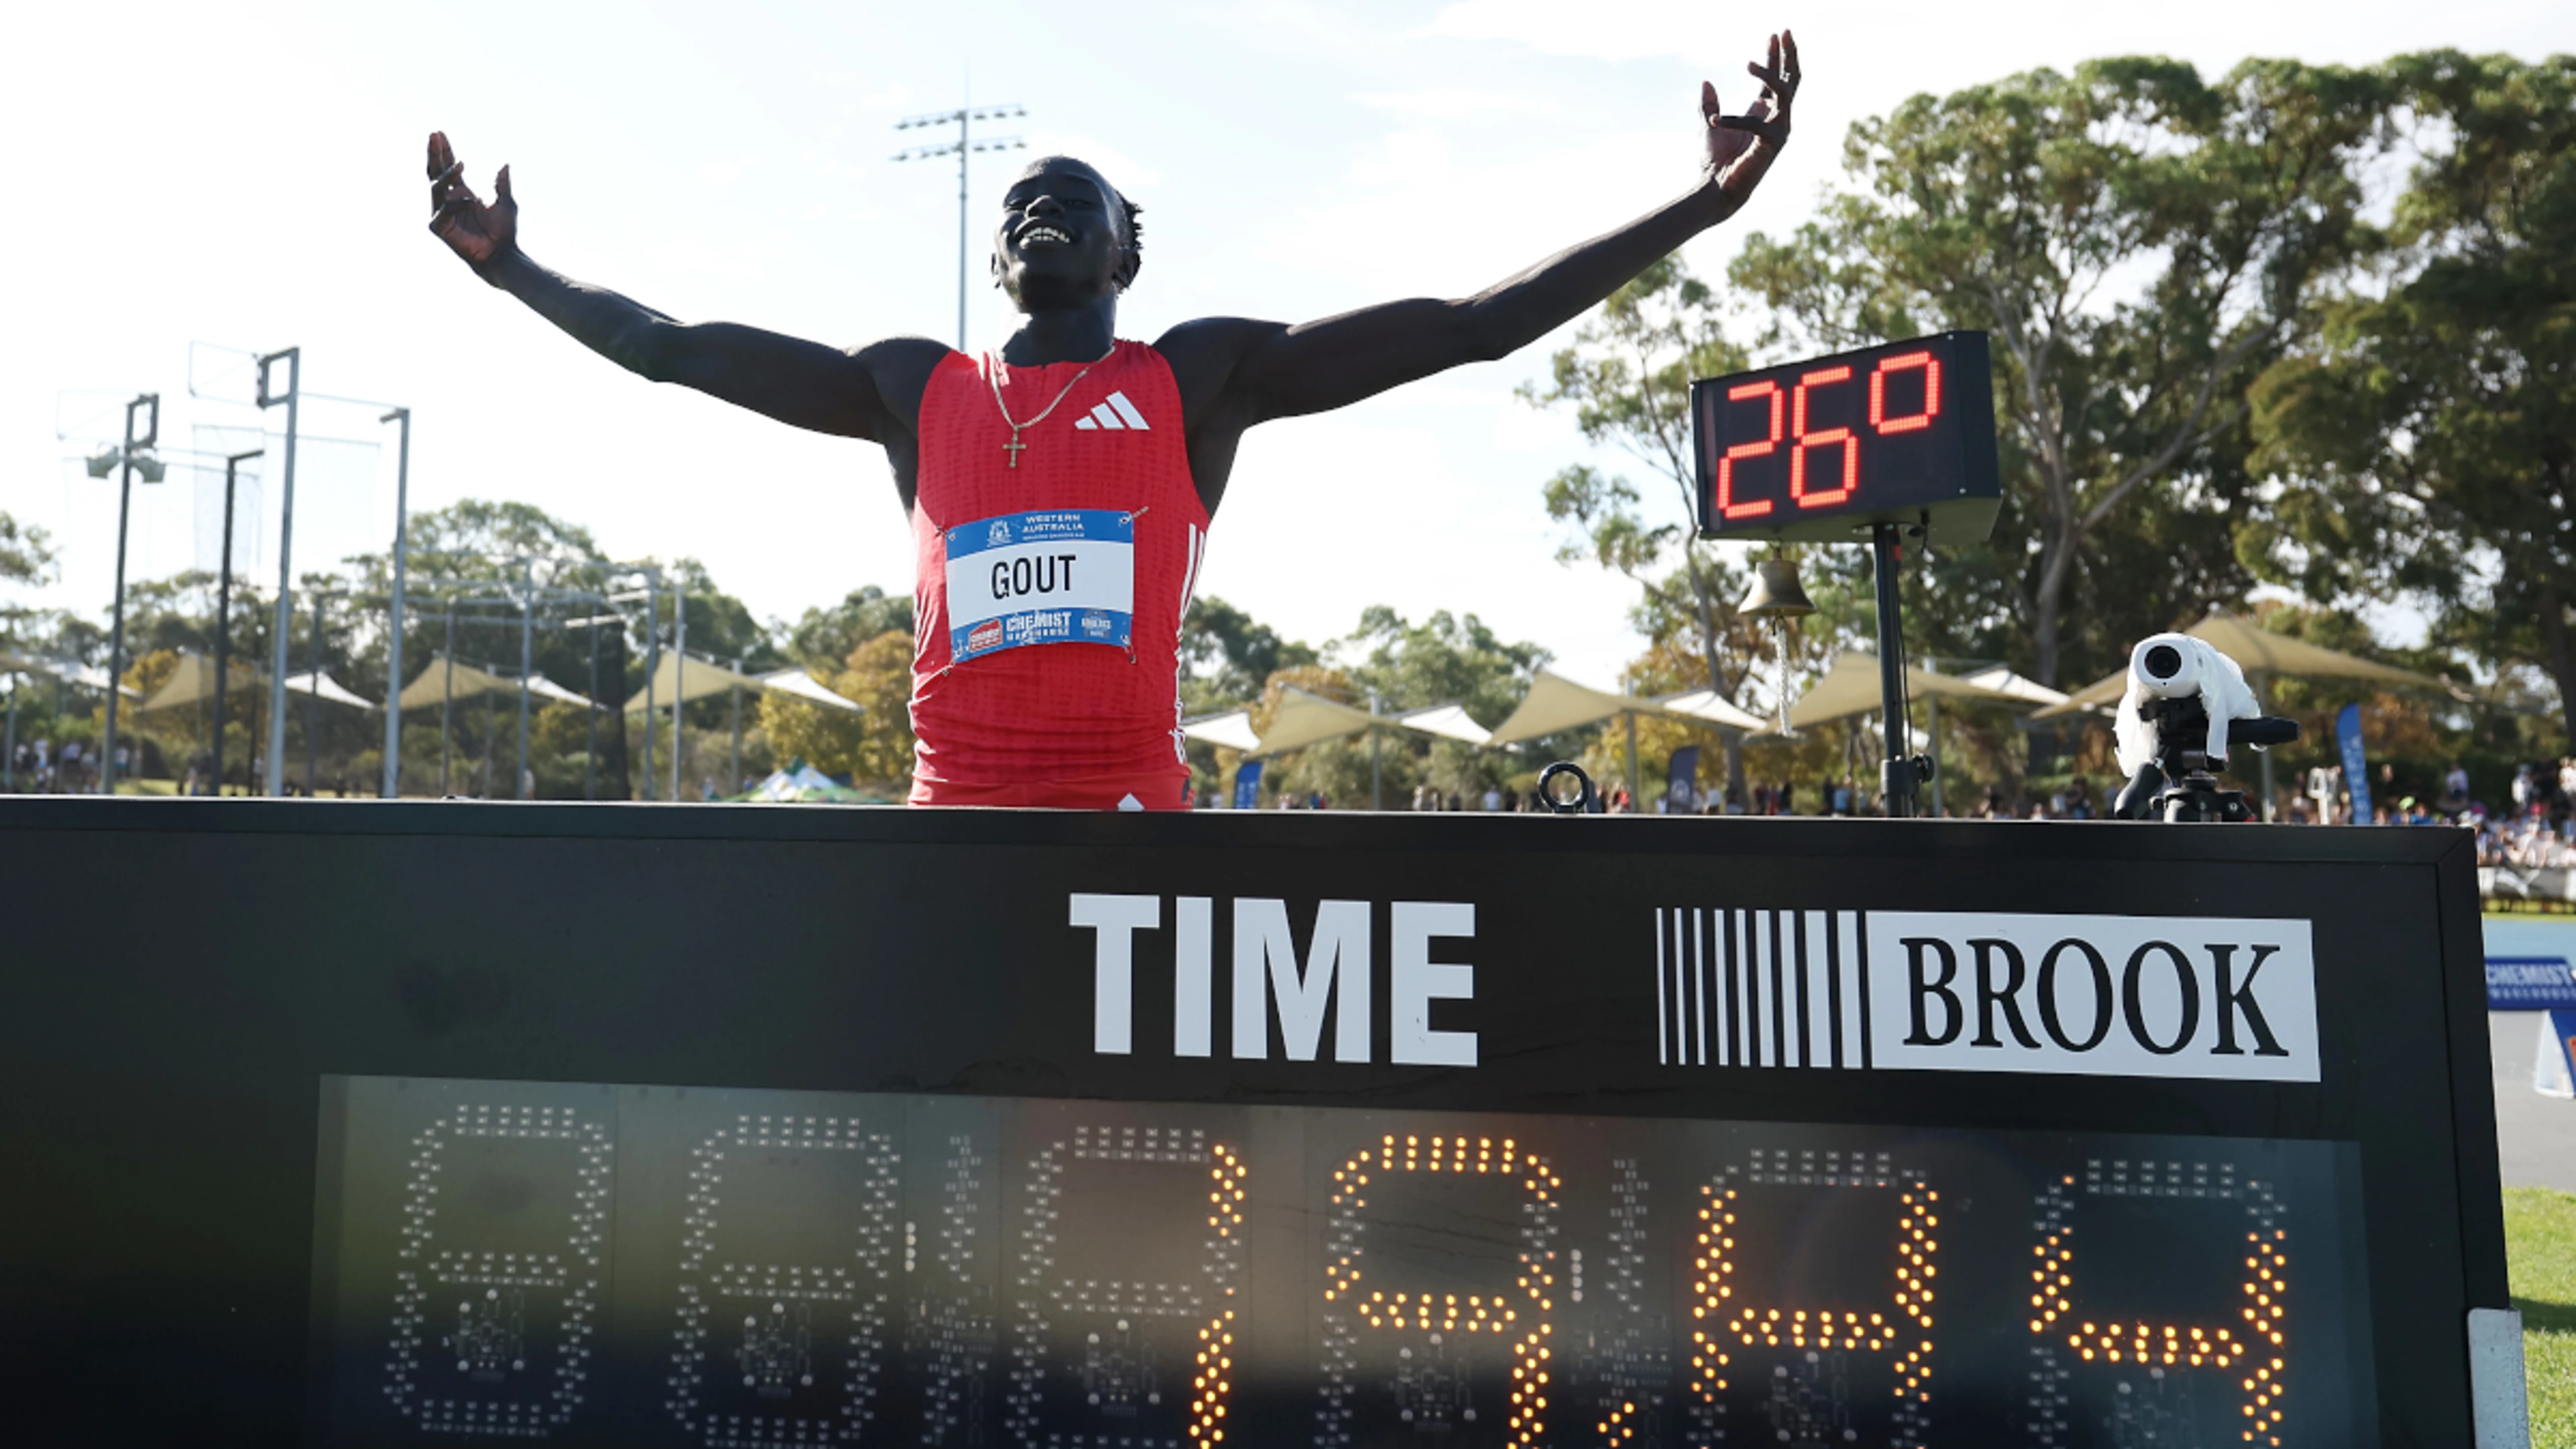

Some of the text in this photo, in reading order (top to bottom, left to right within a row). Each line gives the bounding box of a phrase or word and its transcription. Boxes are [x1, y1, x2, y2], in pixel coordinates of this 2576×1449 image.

[1022, 523, 1085, 533] AUSTRALIA
[1025, 514, 1081, 523] WESTERN
[991, 554, 1076, 600] GOUT
[1006, 611, 1071, 631] CHEMIST
[1069, 893, 1478, 1067] TIME
[1899, 937, 2290, 1057] BROOK
